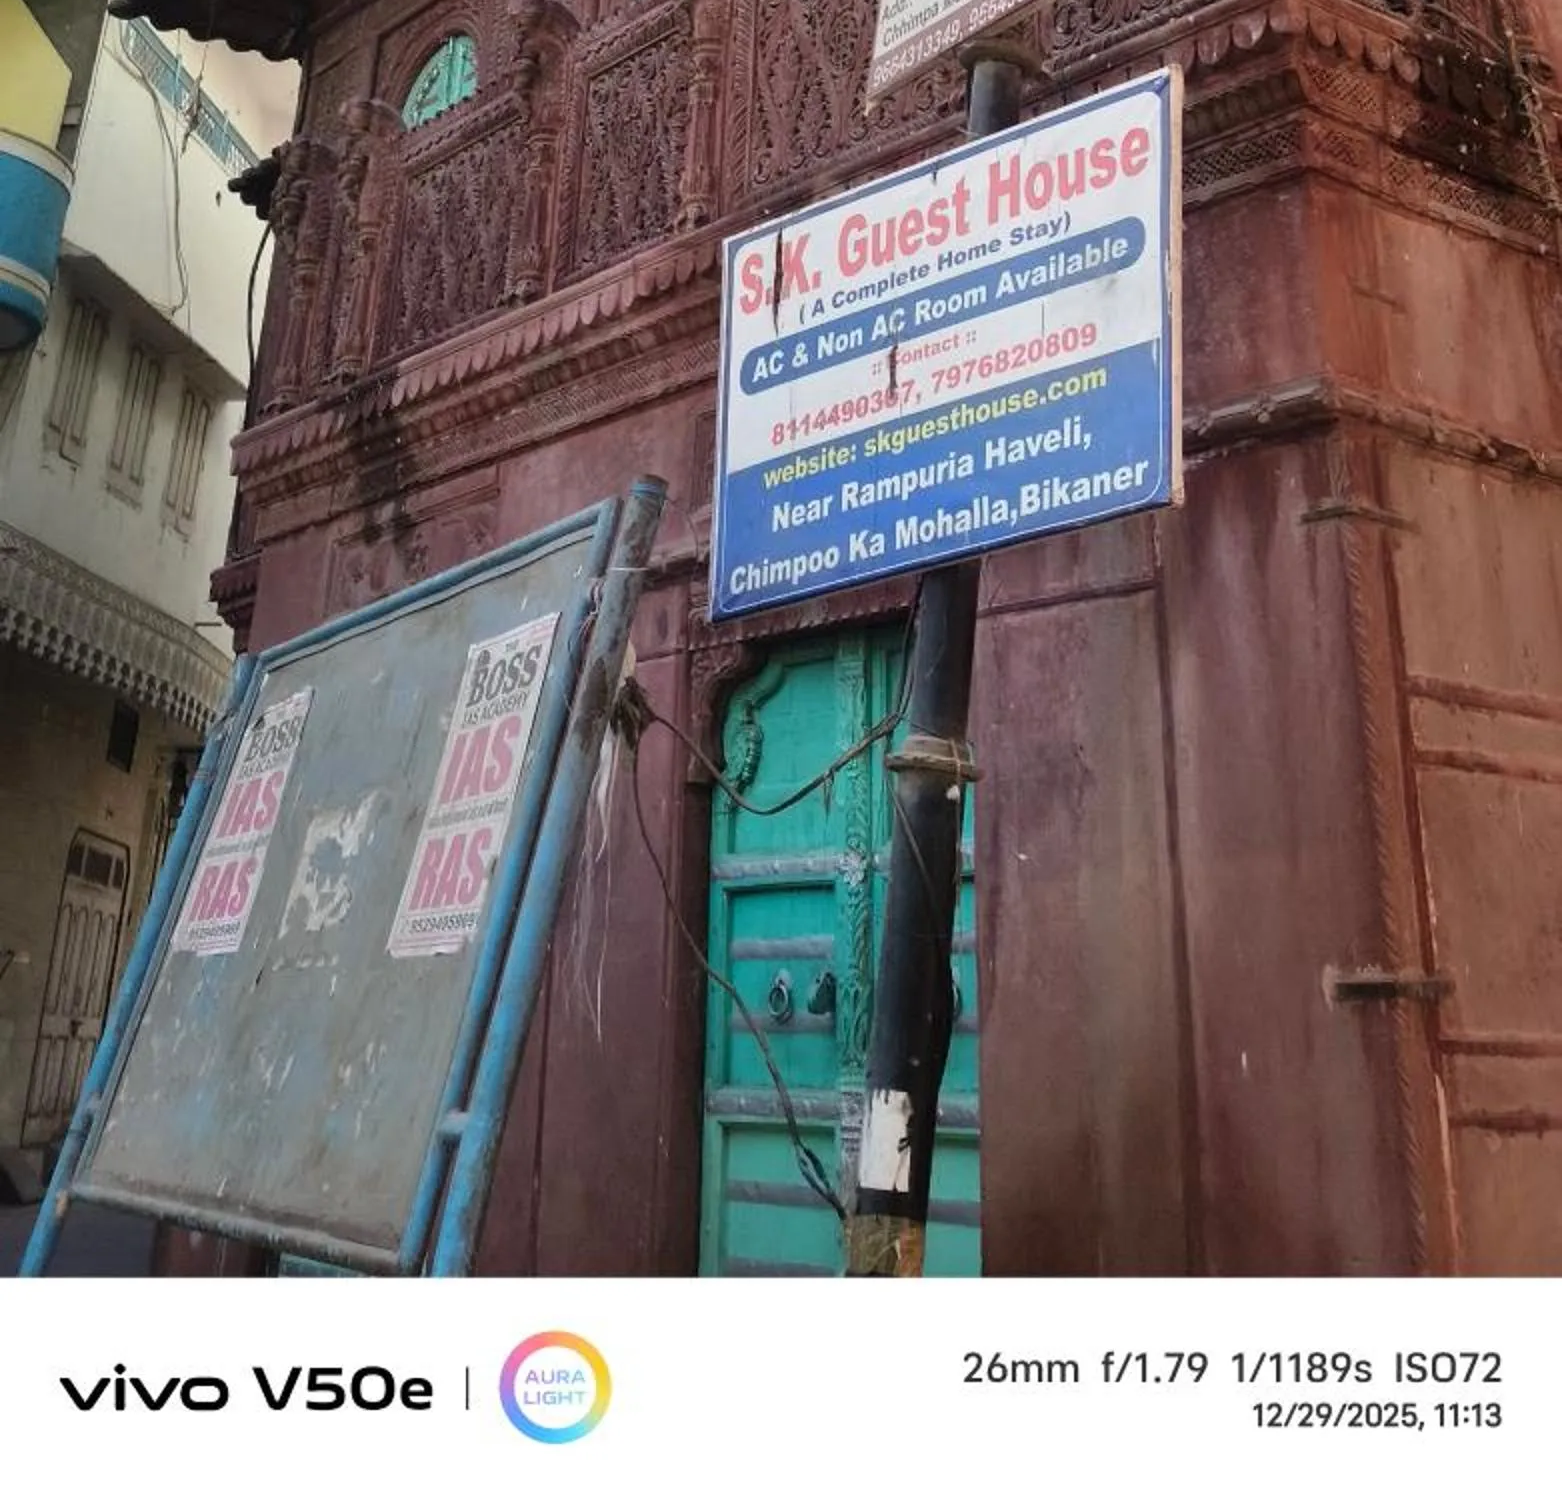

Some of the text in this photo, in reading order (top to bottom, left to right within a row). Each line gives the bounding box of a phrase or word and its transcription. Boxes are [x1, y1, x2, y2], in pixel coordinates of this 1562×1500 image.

[883, 1, 939, 47] Chhimpa
[740, 126, 1151, 315] S.K. Guest House
[831, 263, 930, 310] Complete
[937, 239, 1000, 273] Home
[1009, 210, 1072, 249] Stay)
[752, 234, 1130, 383] AC & Non AC Room Available
[931, 322, 1099, 394] 7976820809
[762, 364, 1108, 491] website: skguesthouse.com
[772, 416, 1092, 533] Near Rampuria Haveli,
[729, 544, 841, 596] Chimpoo
[848, 527, 886, 563] Ka
[466, 644, 542, 708] BOSS
[244, 715, 300, 762] BOSS
[438, 714, 523, 804] IAS
[215, 769, 285, 839] IAS
[189, 856, 257, 922] RAS
[407, 827, 493, 912] RAS
